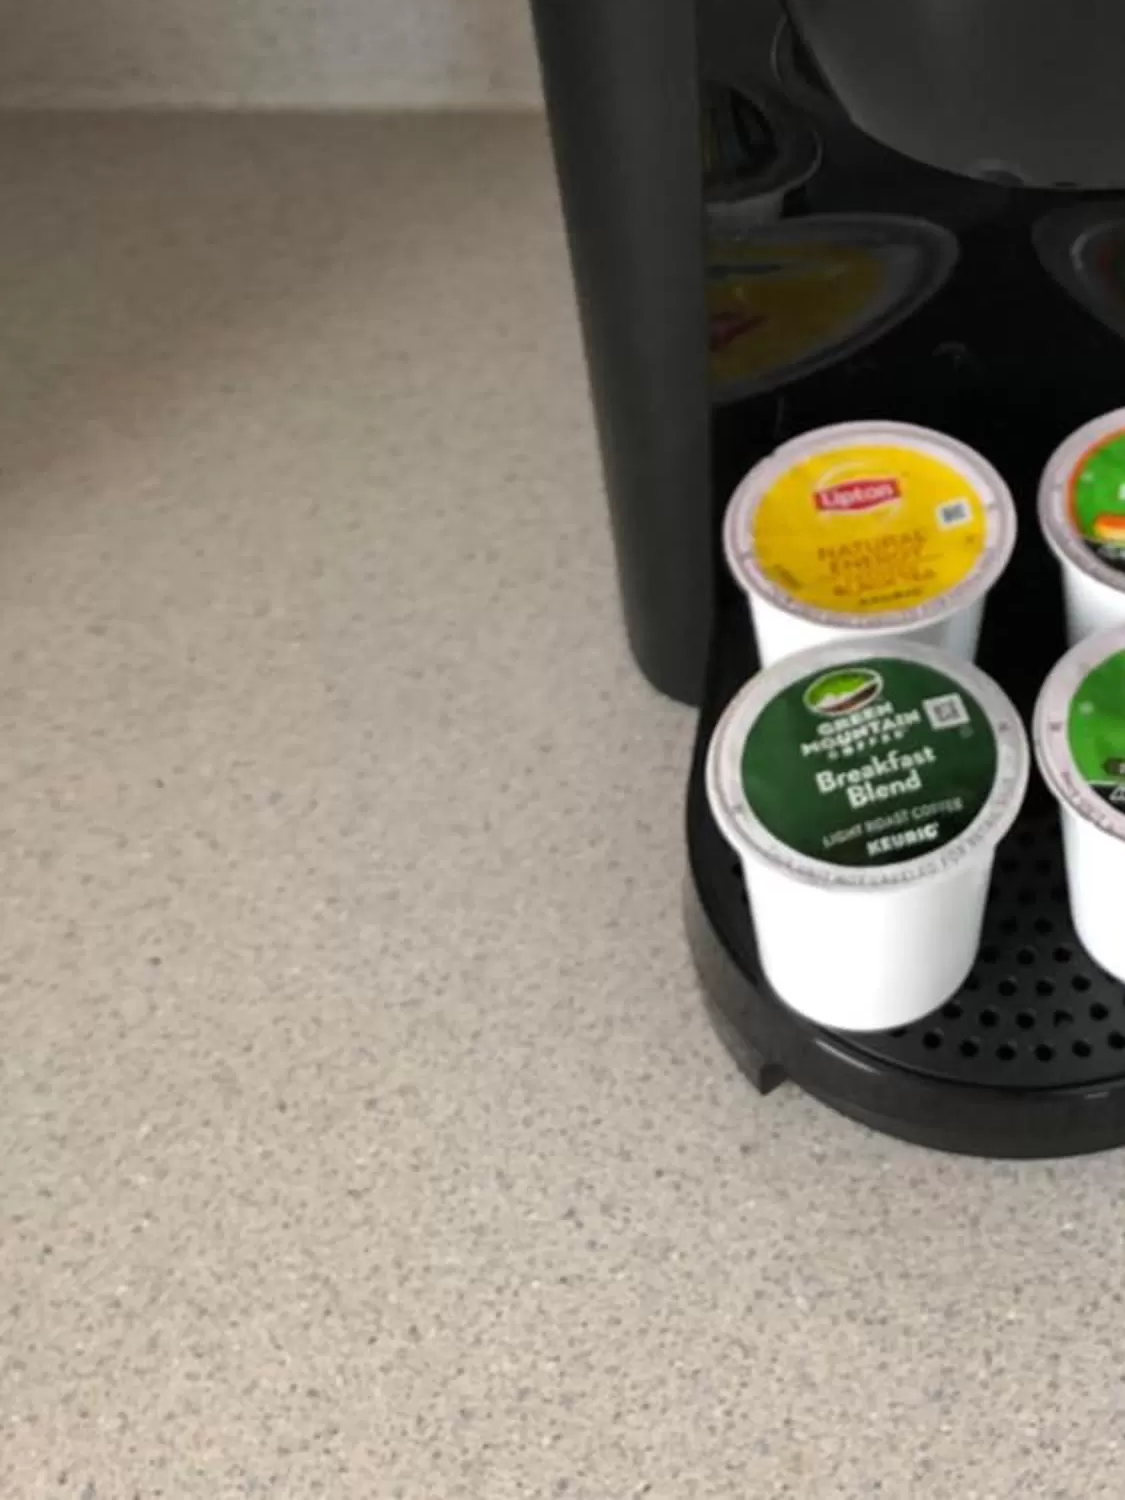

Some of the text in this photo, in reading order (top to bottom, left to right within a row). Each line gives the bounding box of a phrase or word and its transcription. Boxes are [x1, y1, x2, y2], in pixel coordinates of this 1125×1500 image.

[820, 483, 894, 508] Lipton
[801, 709, 921, 756] MOUNTAIN
[817, 701, 894, 736] GREEN
[816, 746, 936, 793] Breakfast
[846, 769, 922, 809] Blend
[866, 822, 939, 856] KEURIG
